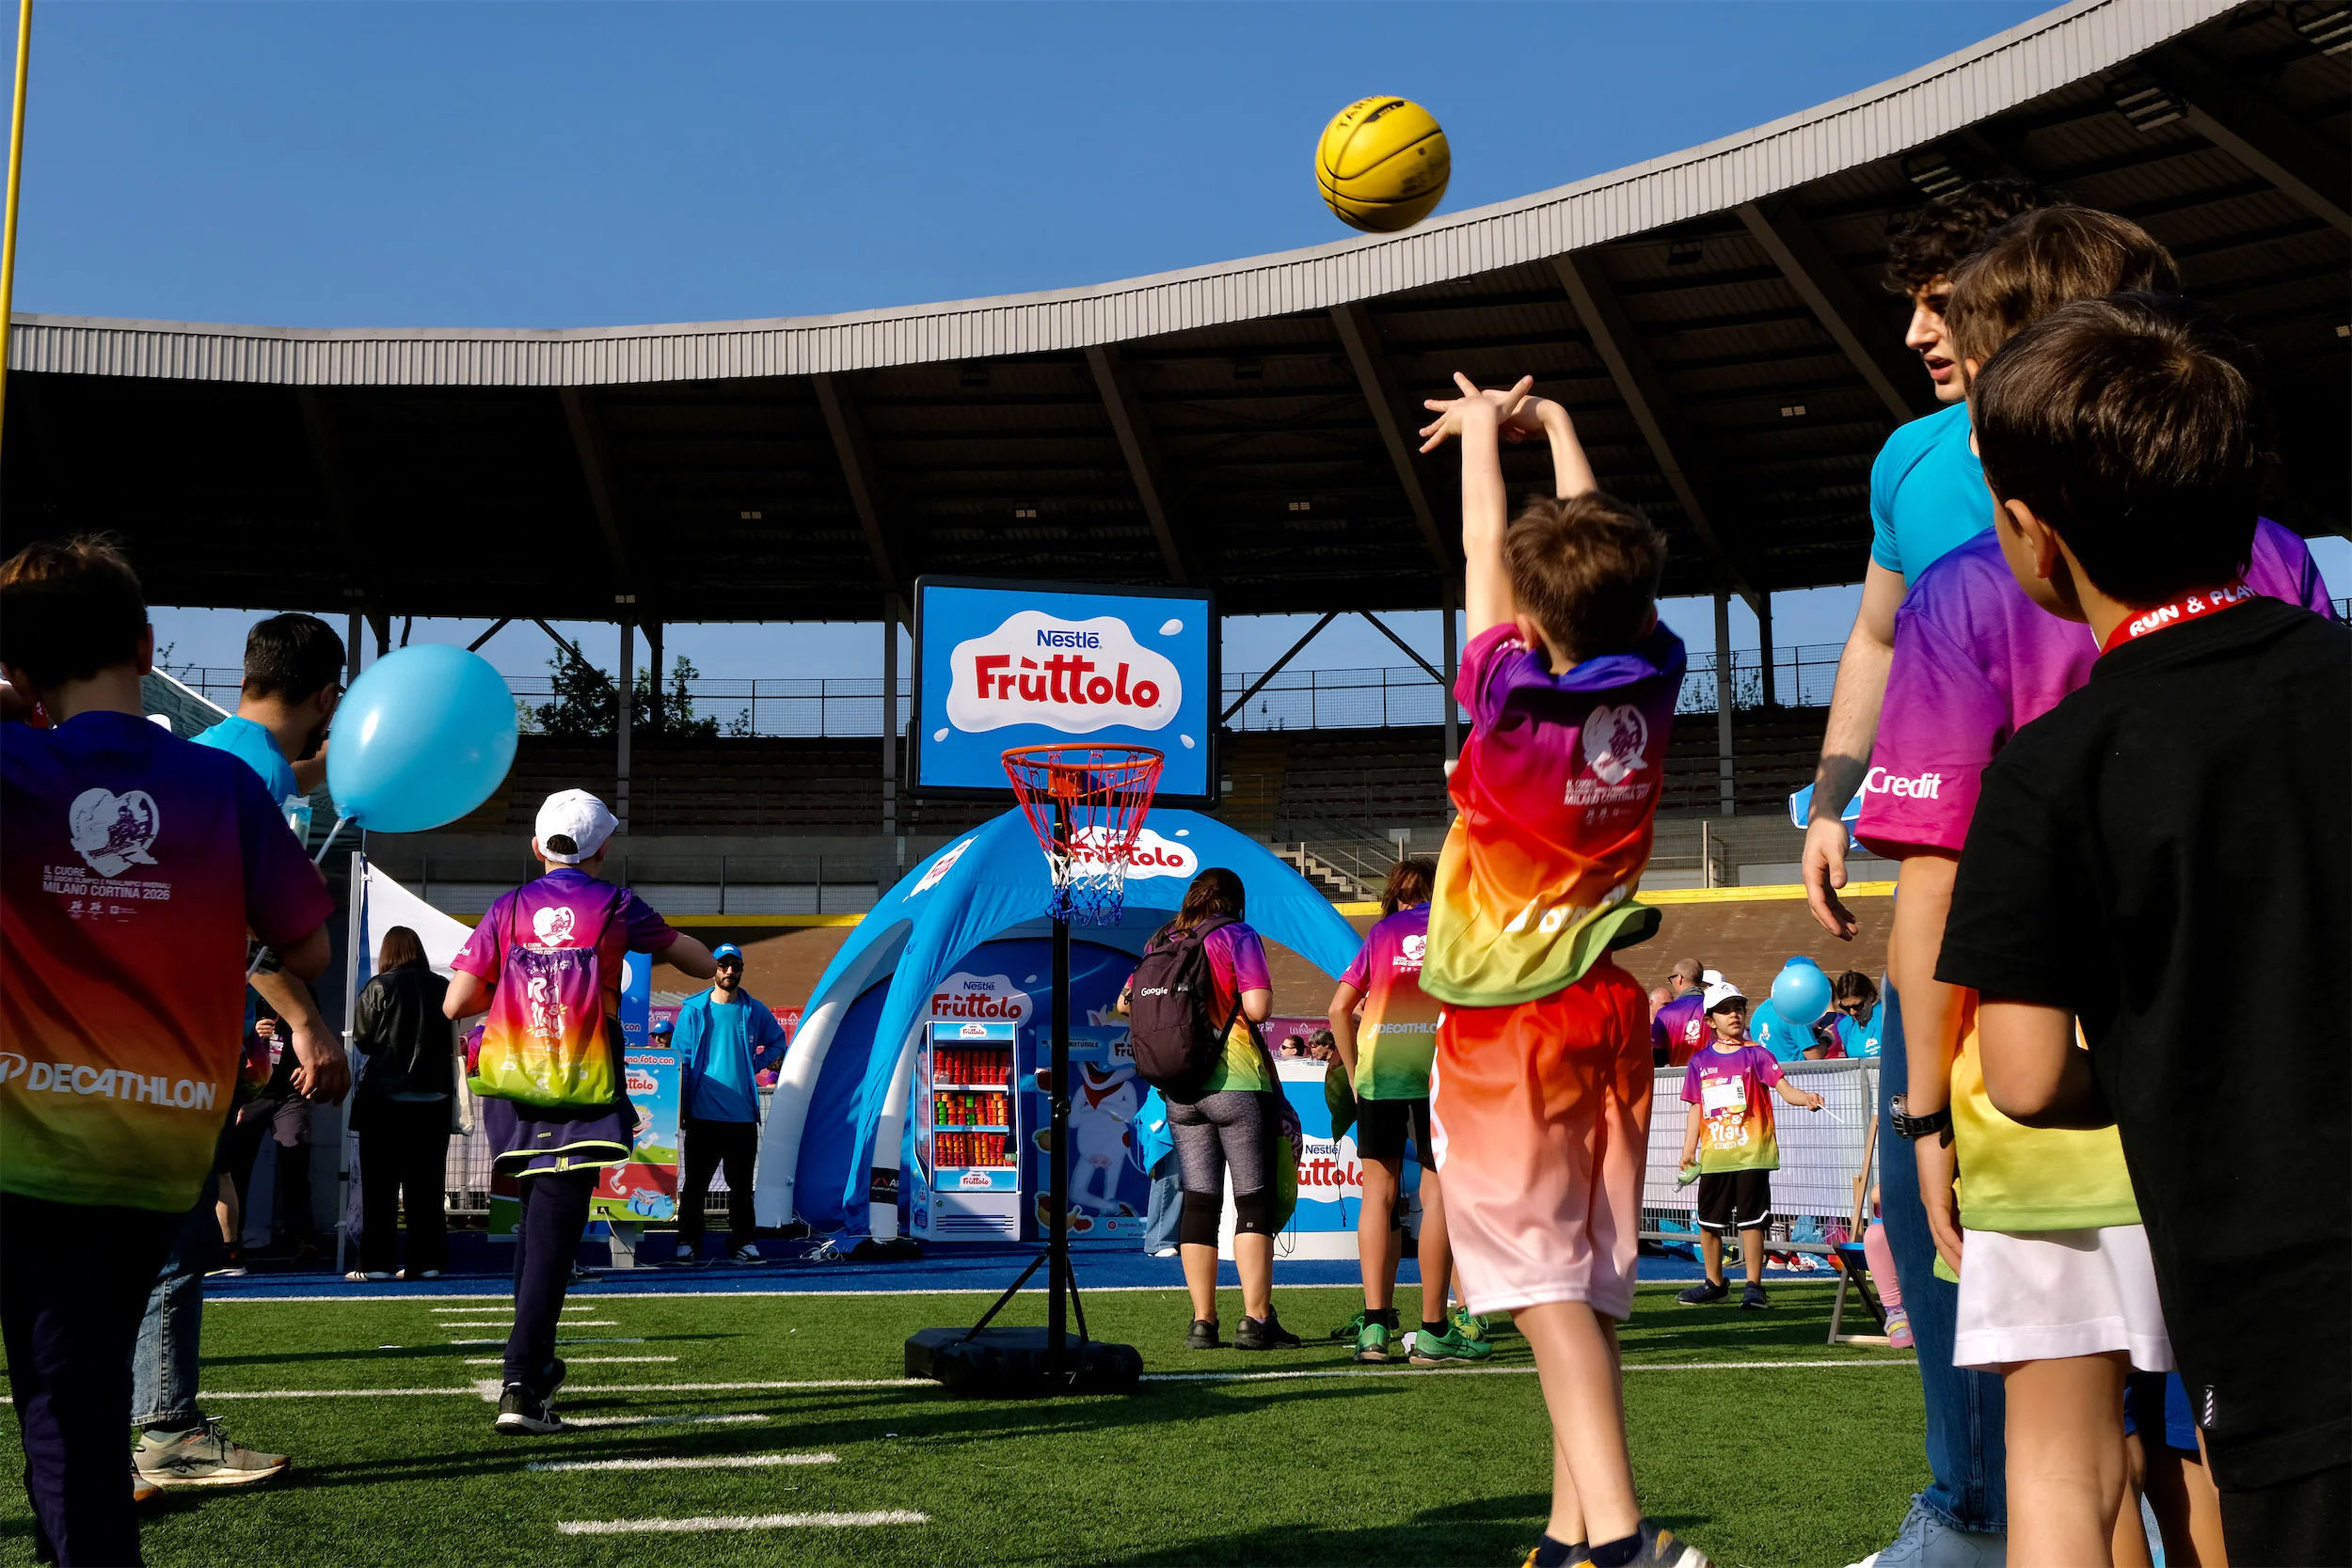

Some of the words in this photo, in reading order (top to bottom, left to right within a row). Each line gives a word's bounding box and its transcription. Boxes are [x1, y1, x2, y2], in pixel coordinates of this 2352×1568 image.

[2129, 605, 2179, 636] RUN
[2186, 596, 2205, 613] &
[975, 654, 1160, 708] Frùttolo
[1866, 766, 1942, 800] Credit
[43, 865, 53, 875] IL
[55, 866, 86, 878] CUORE
[42, 881, 87, 895] MILANO
[90, 885, 140, 898] CORTINA
[143, 888, 170, 900] 2026
[1141, 987, 1168, 996] Google
[931, 992, 1022, 1019] Frùttolo
[1379, 1022, 1438, 1034] DECATHLO
[641, 1054, 658, 1064] foto
[26, 1061, 216, 1110] DECATHLON
[628, 1077, 654, 1090] ttolo
[1708, 1121, 1749, 1147] Play
